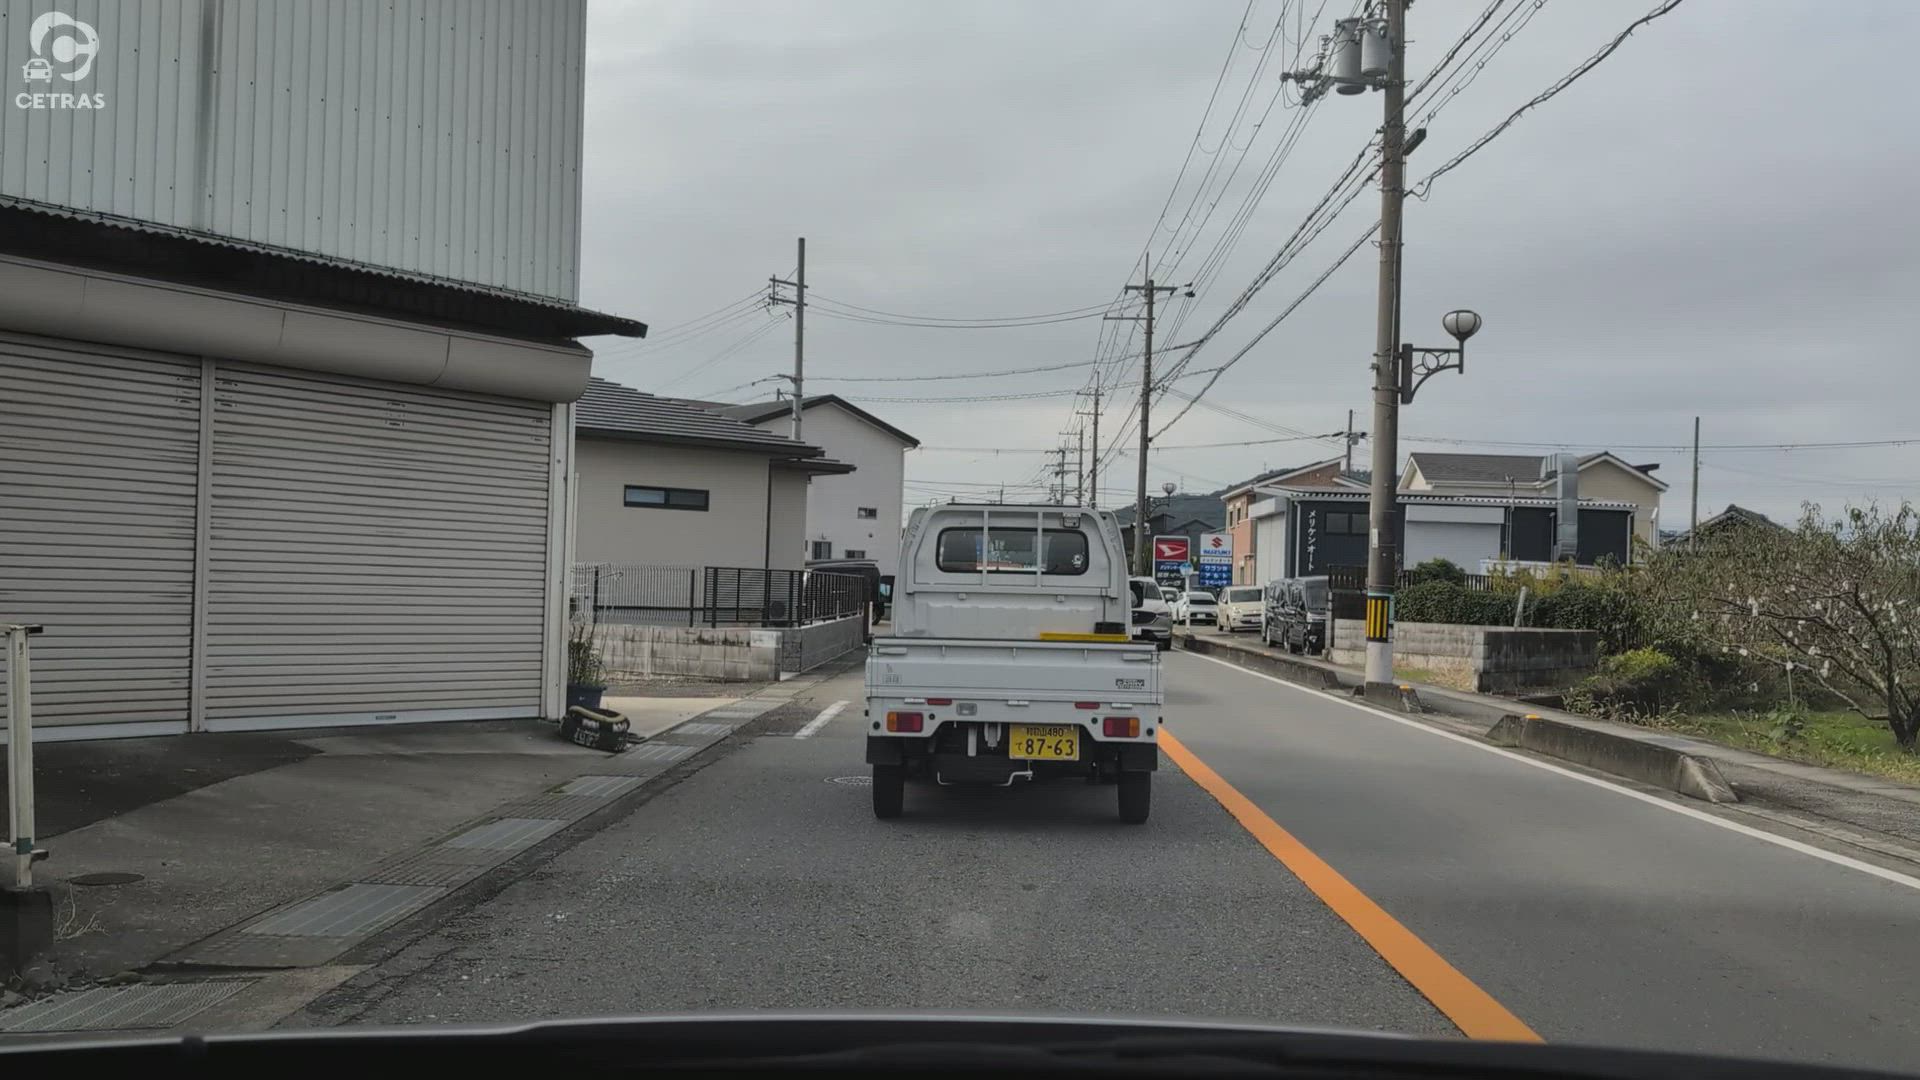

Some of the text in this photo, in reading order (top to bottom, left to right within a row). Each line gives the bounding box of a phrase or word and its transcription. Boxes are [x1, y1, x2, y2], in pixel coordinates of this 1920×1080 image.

[1307, 510, 1317, 572] メリケンオート
[1025, 738, 1074, 756] 87-63
